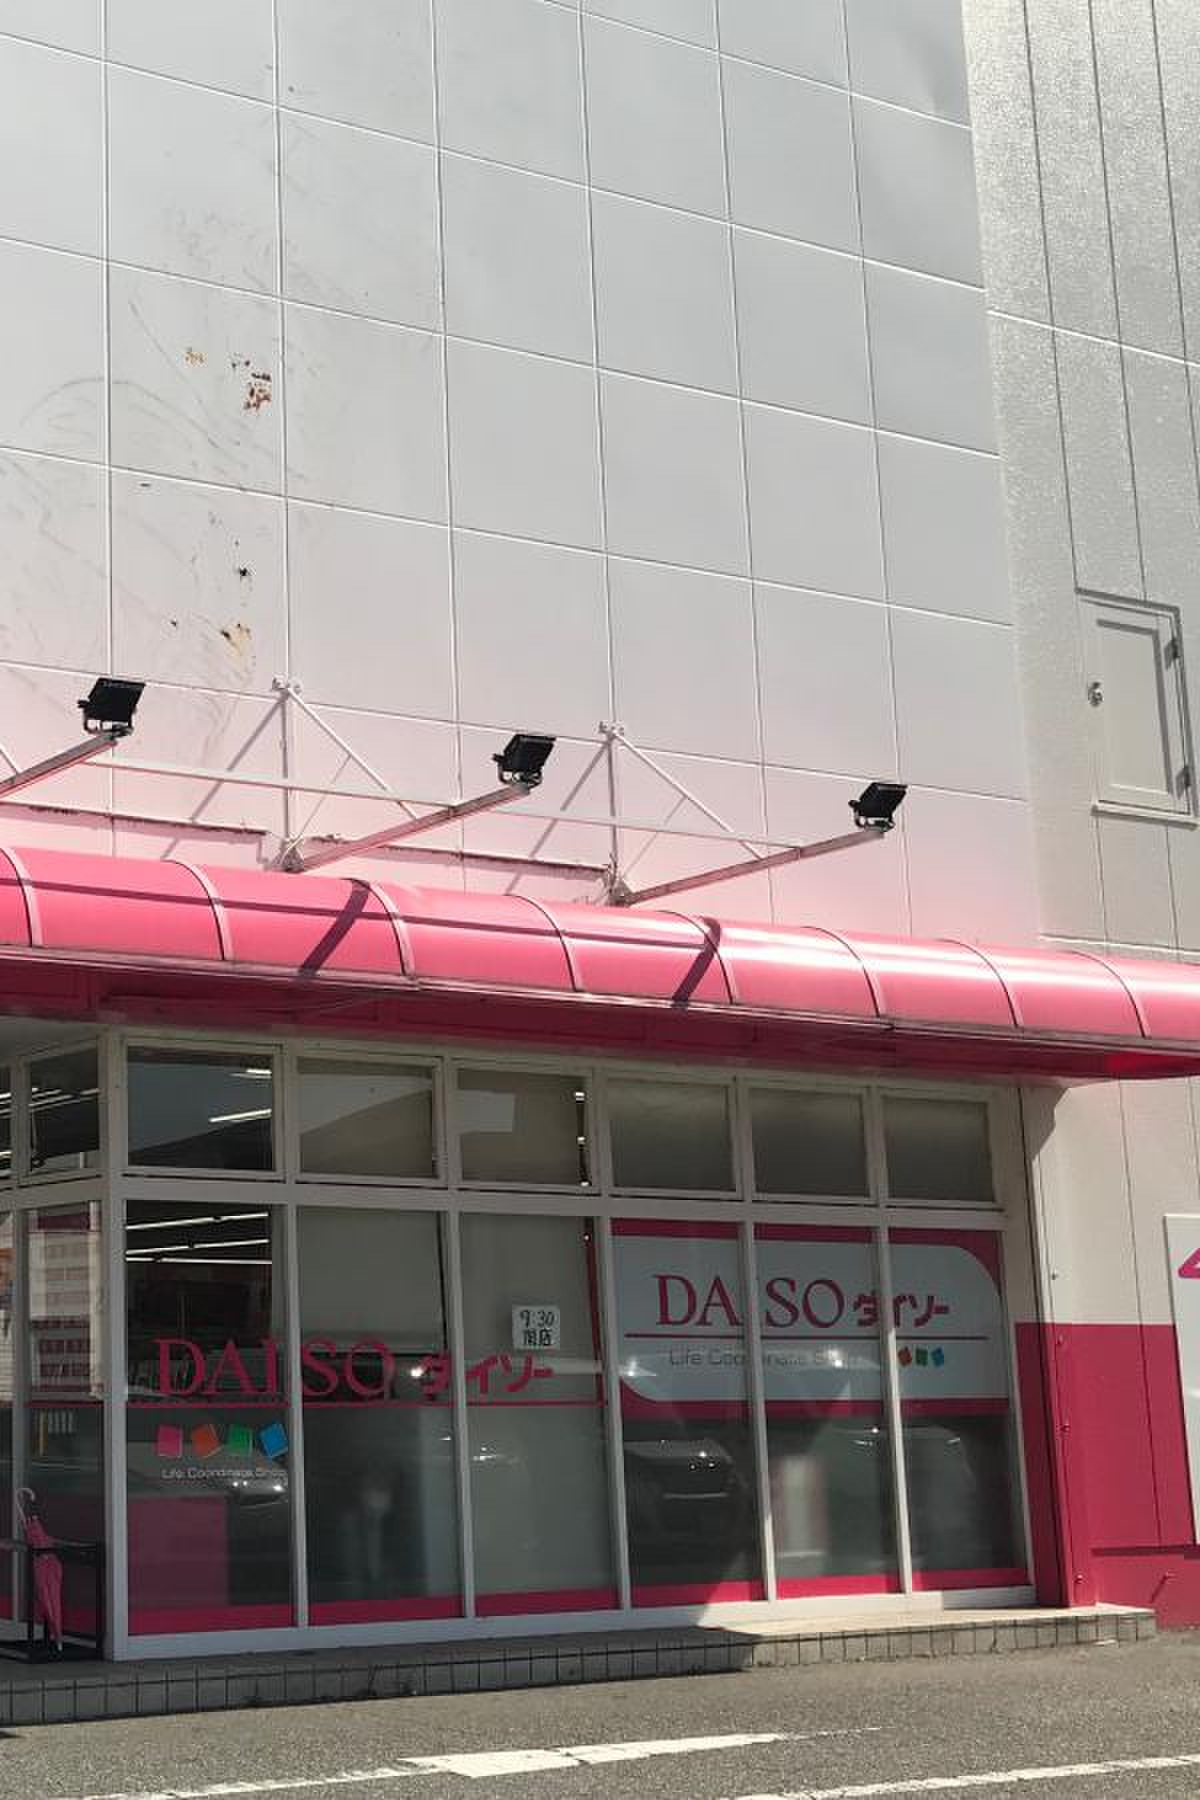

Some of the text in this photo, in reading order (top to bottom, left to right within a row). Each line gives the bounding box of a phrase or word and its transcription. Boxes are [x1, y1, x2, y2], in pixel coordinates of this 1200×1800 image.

[520, 1309, 555, 1328] 9:30
[654, 1274, 845, 1329] DASO
[152, 1337, 396, 1398] DAISO
